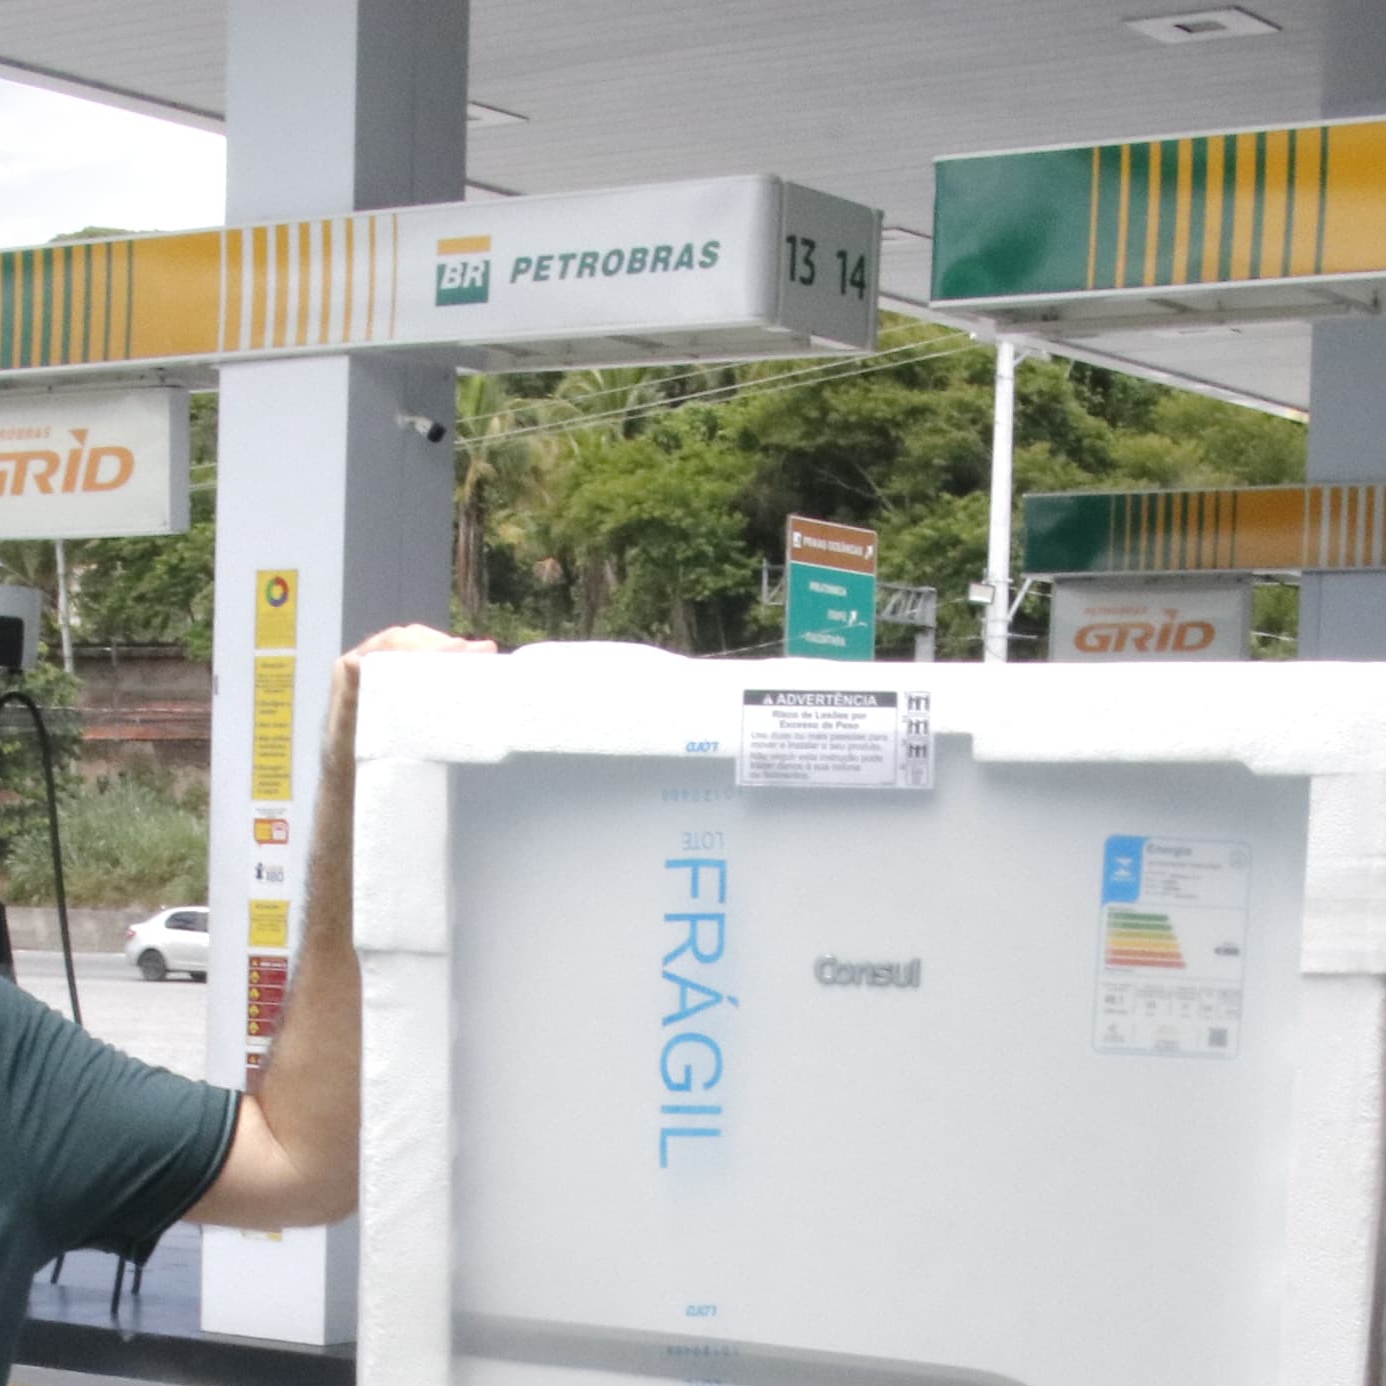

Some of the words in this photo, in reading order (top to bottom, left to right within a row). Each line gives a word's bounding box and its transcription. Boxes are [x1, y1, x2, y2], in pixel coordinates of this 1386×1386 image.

[438, 258, 488, 290] BR
[509, 240, 721, 284] PETROBRAS
[786, 235, 815, 286] 13
[835, 249, 867, 300] 14
[1074, 609, 1216, 653] GRID
[776, 692, 878, 705] ADVERTÊNCIA
[813, 953, 922, 988] Consul
[658, 858, 740, 1169] FRÁGIL
